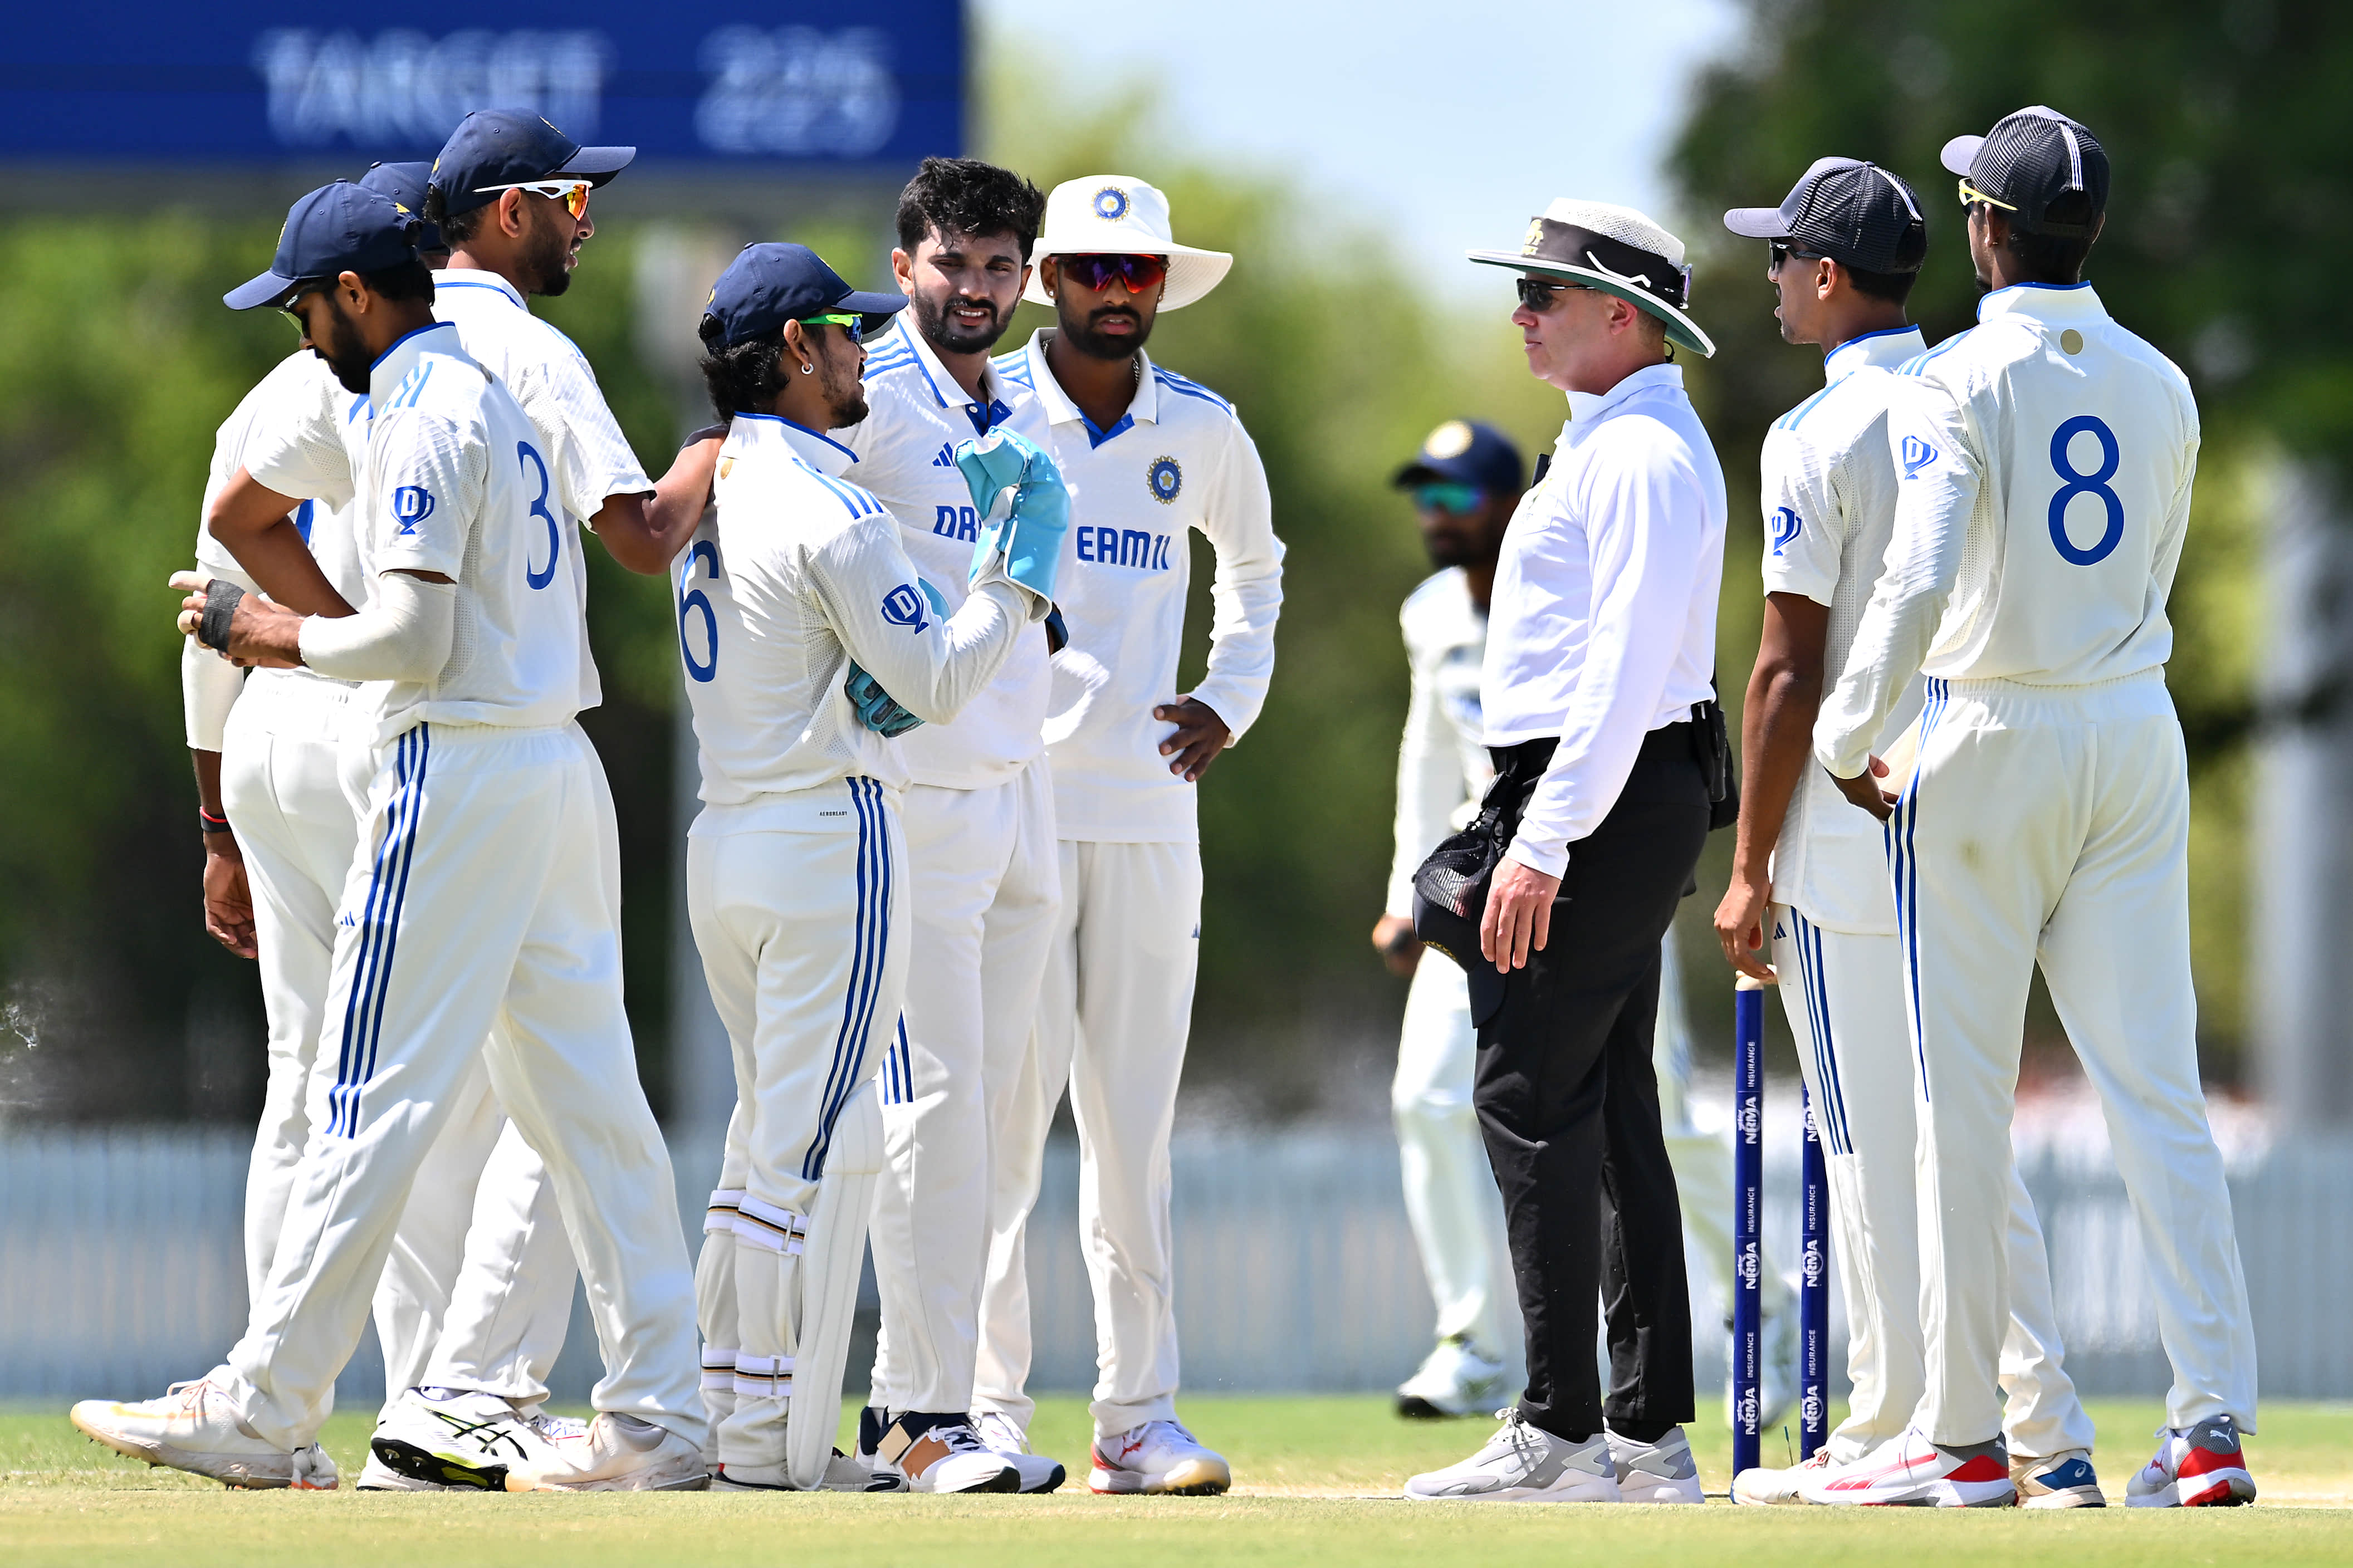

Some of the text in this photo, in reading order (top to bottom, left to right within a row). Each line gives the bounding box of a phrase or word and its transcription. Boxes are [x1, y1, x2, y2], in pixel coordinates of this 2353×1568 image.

[253, 29, 611, 146] TARGET
[2048, 415, 2124, 566] 8
[517, 441, 560, 590] 3
[933, 506, 982, 543] DR
[1077, 526, 1171, 570] EAM11
[679, 540, 718, 682] 6
[1745, 1096, 1757, 1144] NRMA
[1807, 1096, 1818, 1142] NR
[1745, 1242, 1757, 1290] NRMA
[1807, 1239, 1818, 1287] NRMA
[1745, 1387, 1756, 1435] NRMA
[1807, 1385, 1818, 1433] NRMA
